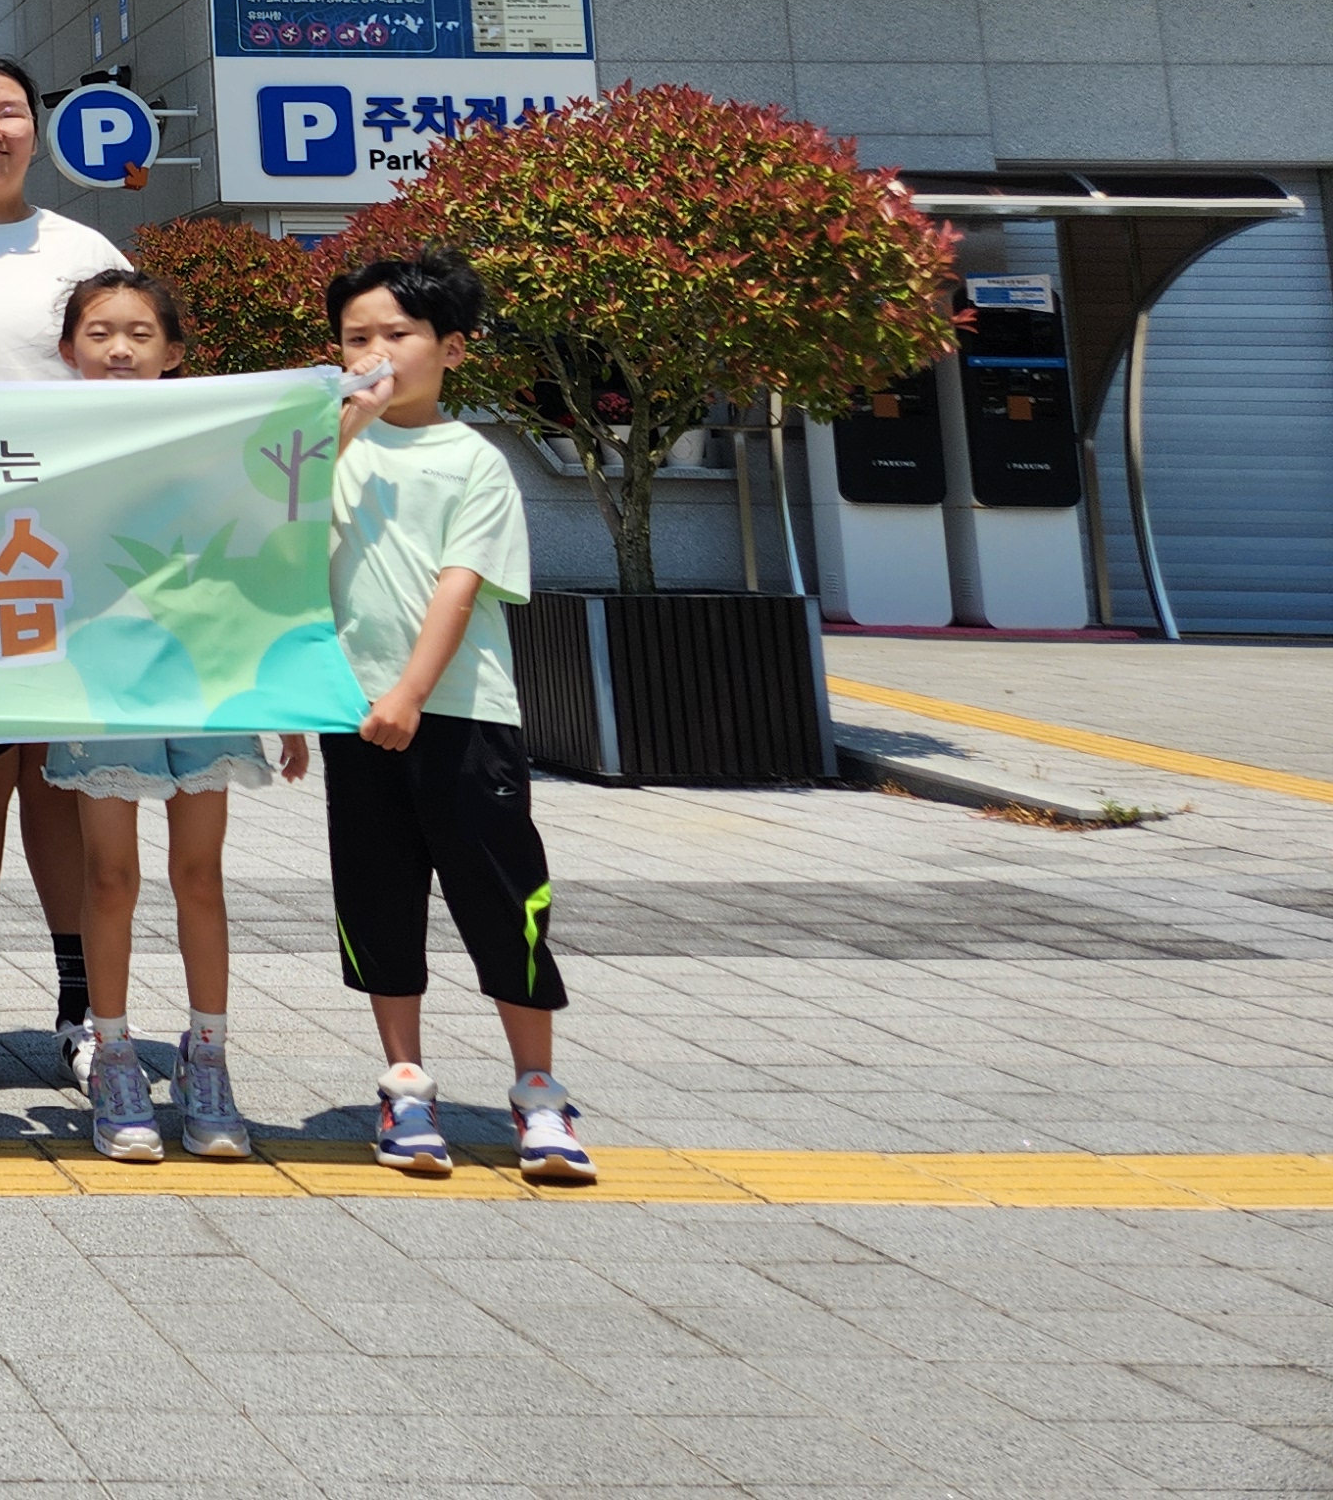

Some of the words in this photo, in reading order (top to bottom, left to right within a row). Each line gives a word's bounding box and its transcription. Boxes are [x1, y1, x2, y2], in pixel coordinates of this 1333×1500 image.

[247, 10, 282, 21] 유의사항
[79, 107, 134, 167] P
[282, 101, 338, 162] P
